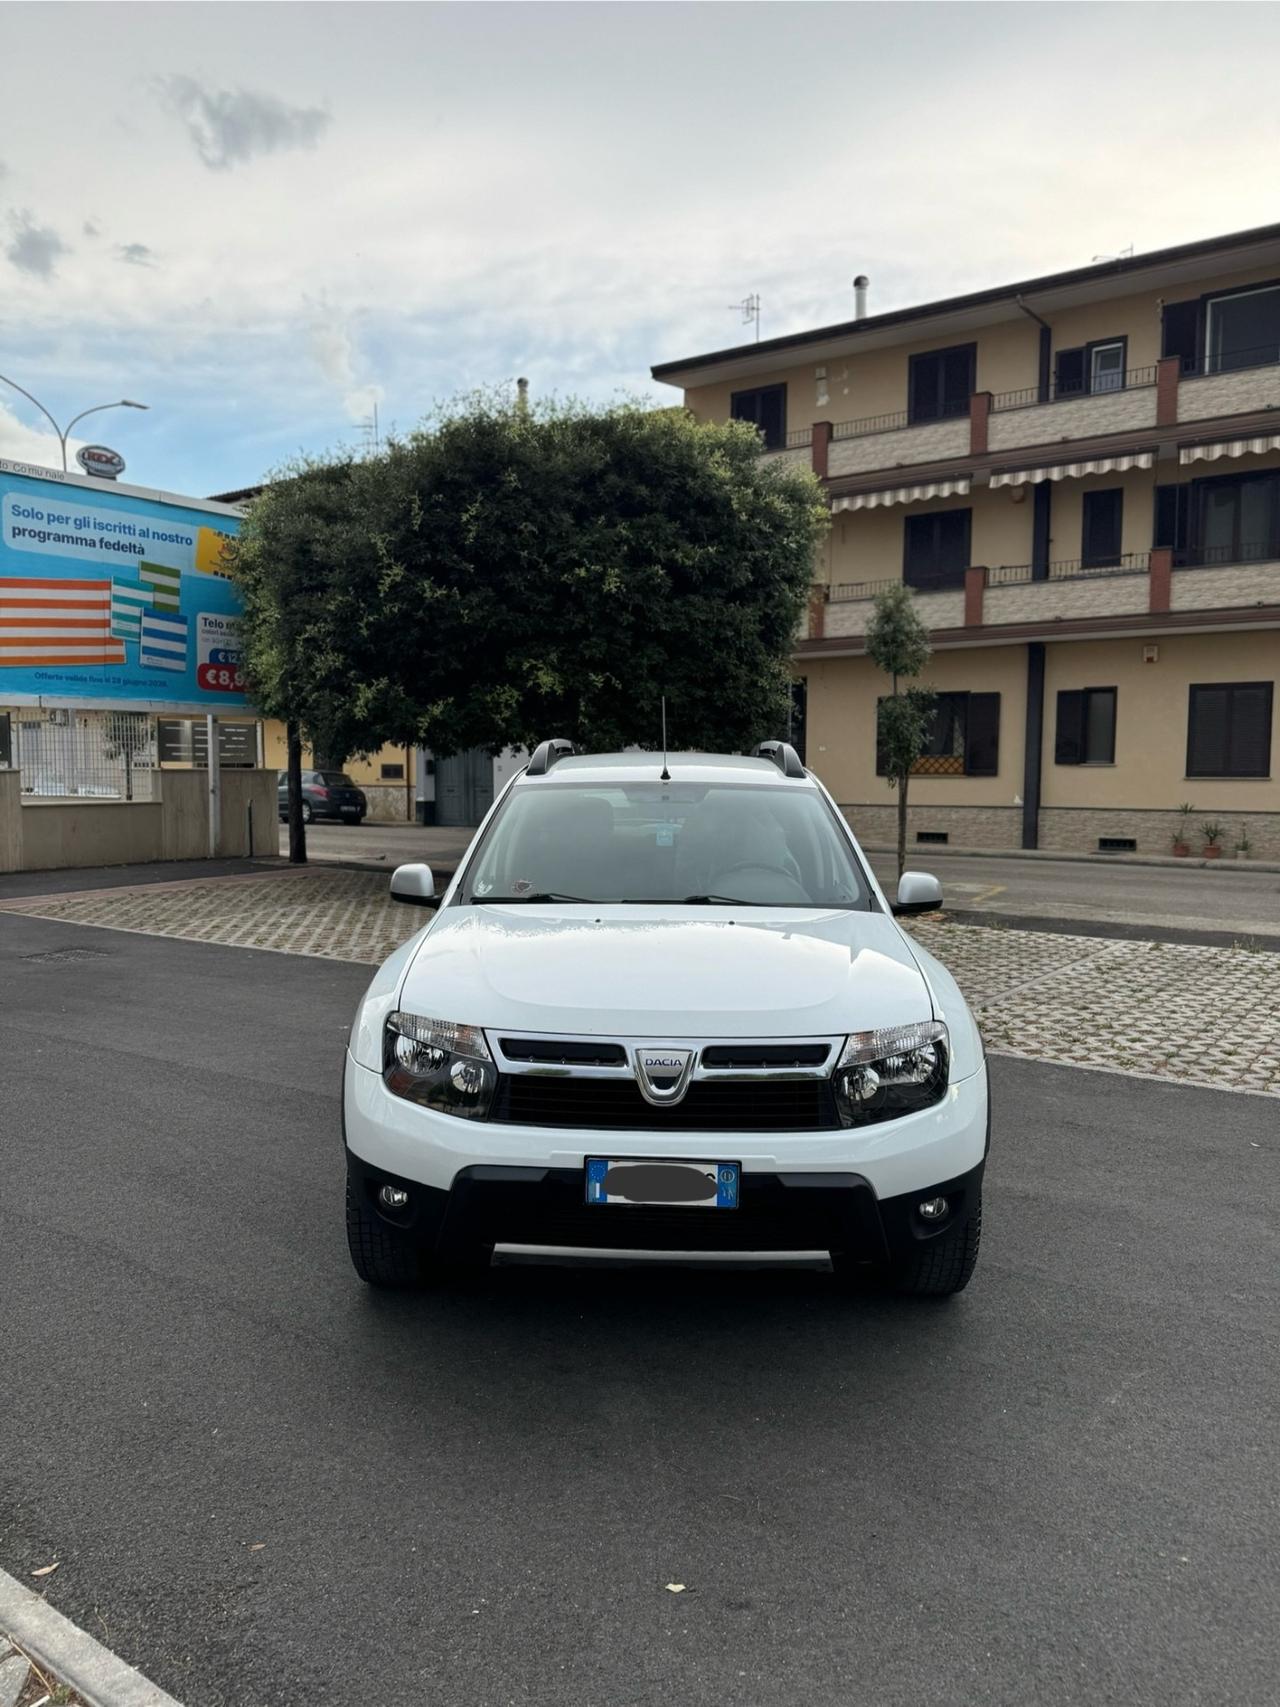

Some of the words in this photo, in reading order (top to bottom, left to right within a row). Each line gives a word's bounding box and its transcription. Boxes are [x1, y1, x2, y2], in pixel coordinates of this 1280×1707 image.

[11, 504, 44, 521] Solo
[47, 512, 72, 526] per
[74, 515, 91, 530] gli
[93, 517, 136, 537] iscritti
[138, 527, 150, 539] al
[152, 530, 193, 546] nostro
[12, 526, 96, 548] programma
[99, 537, 145, 556] fedeltà
[202, 616, 224, 629] Telo
[34, 671, 63, 681] Offerte
[645, 1058, 683, 1067] DACIA
